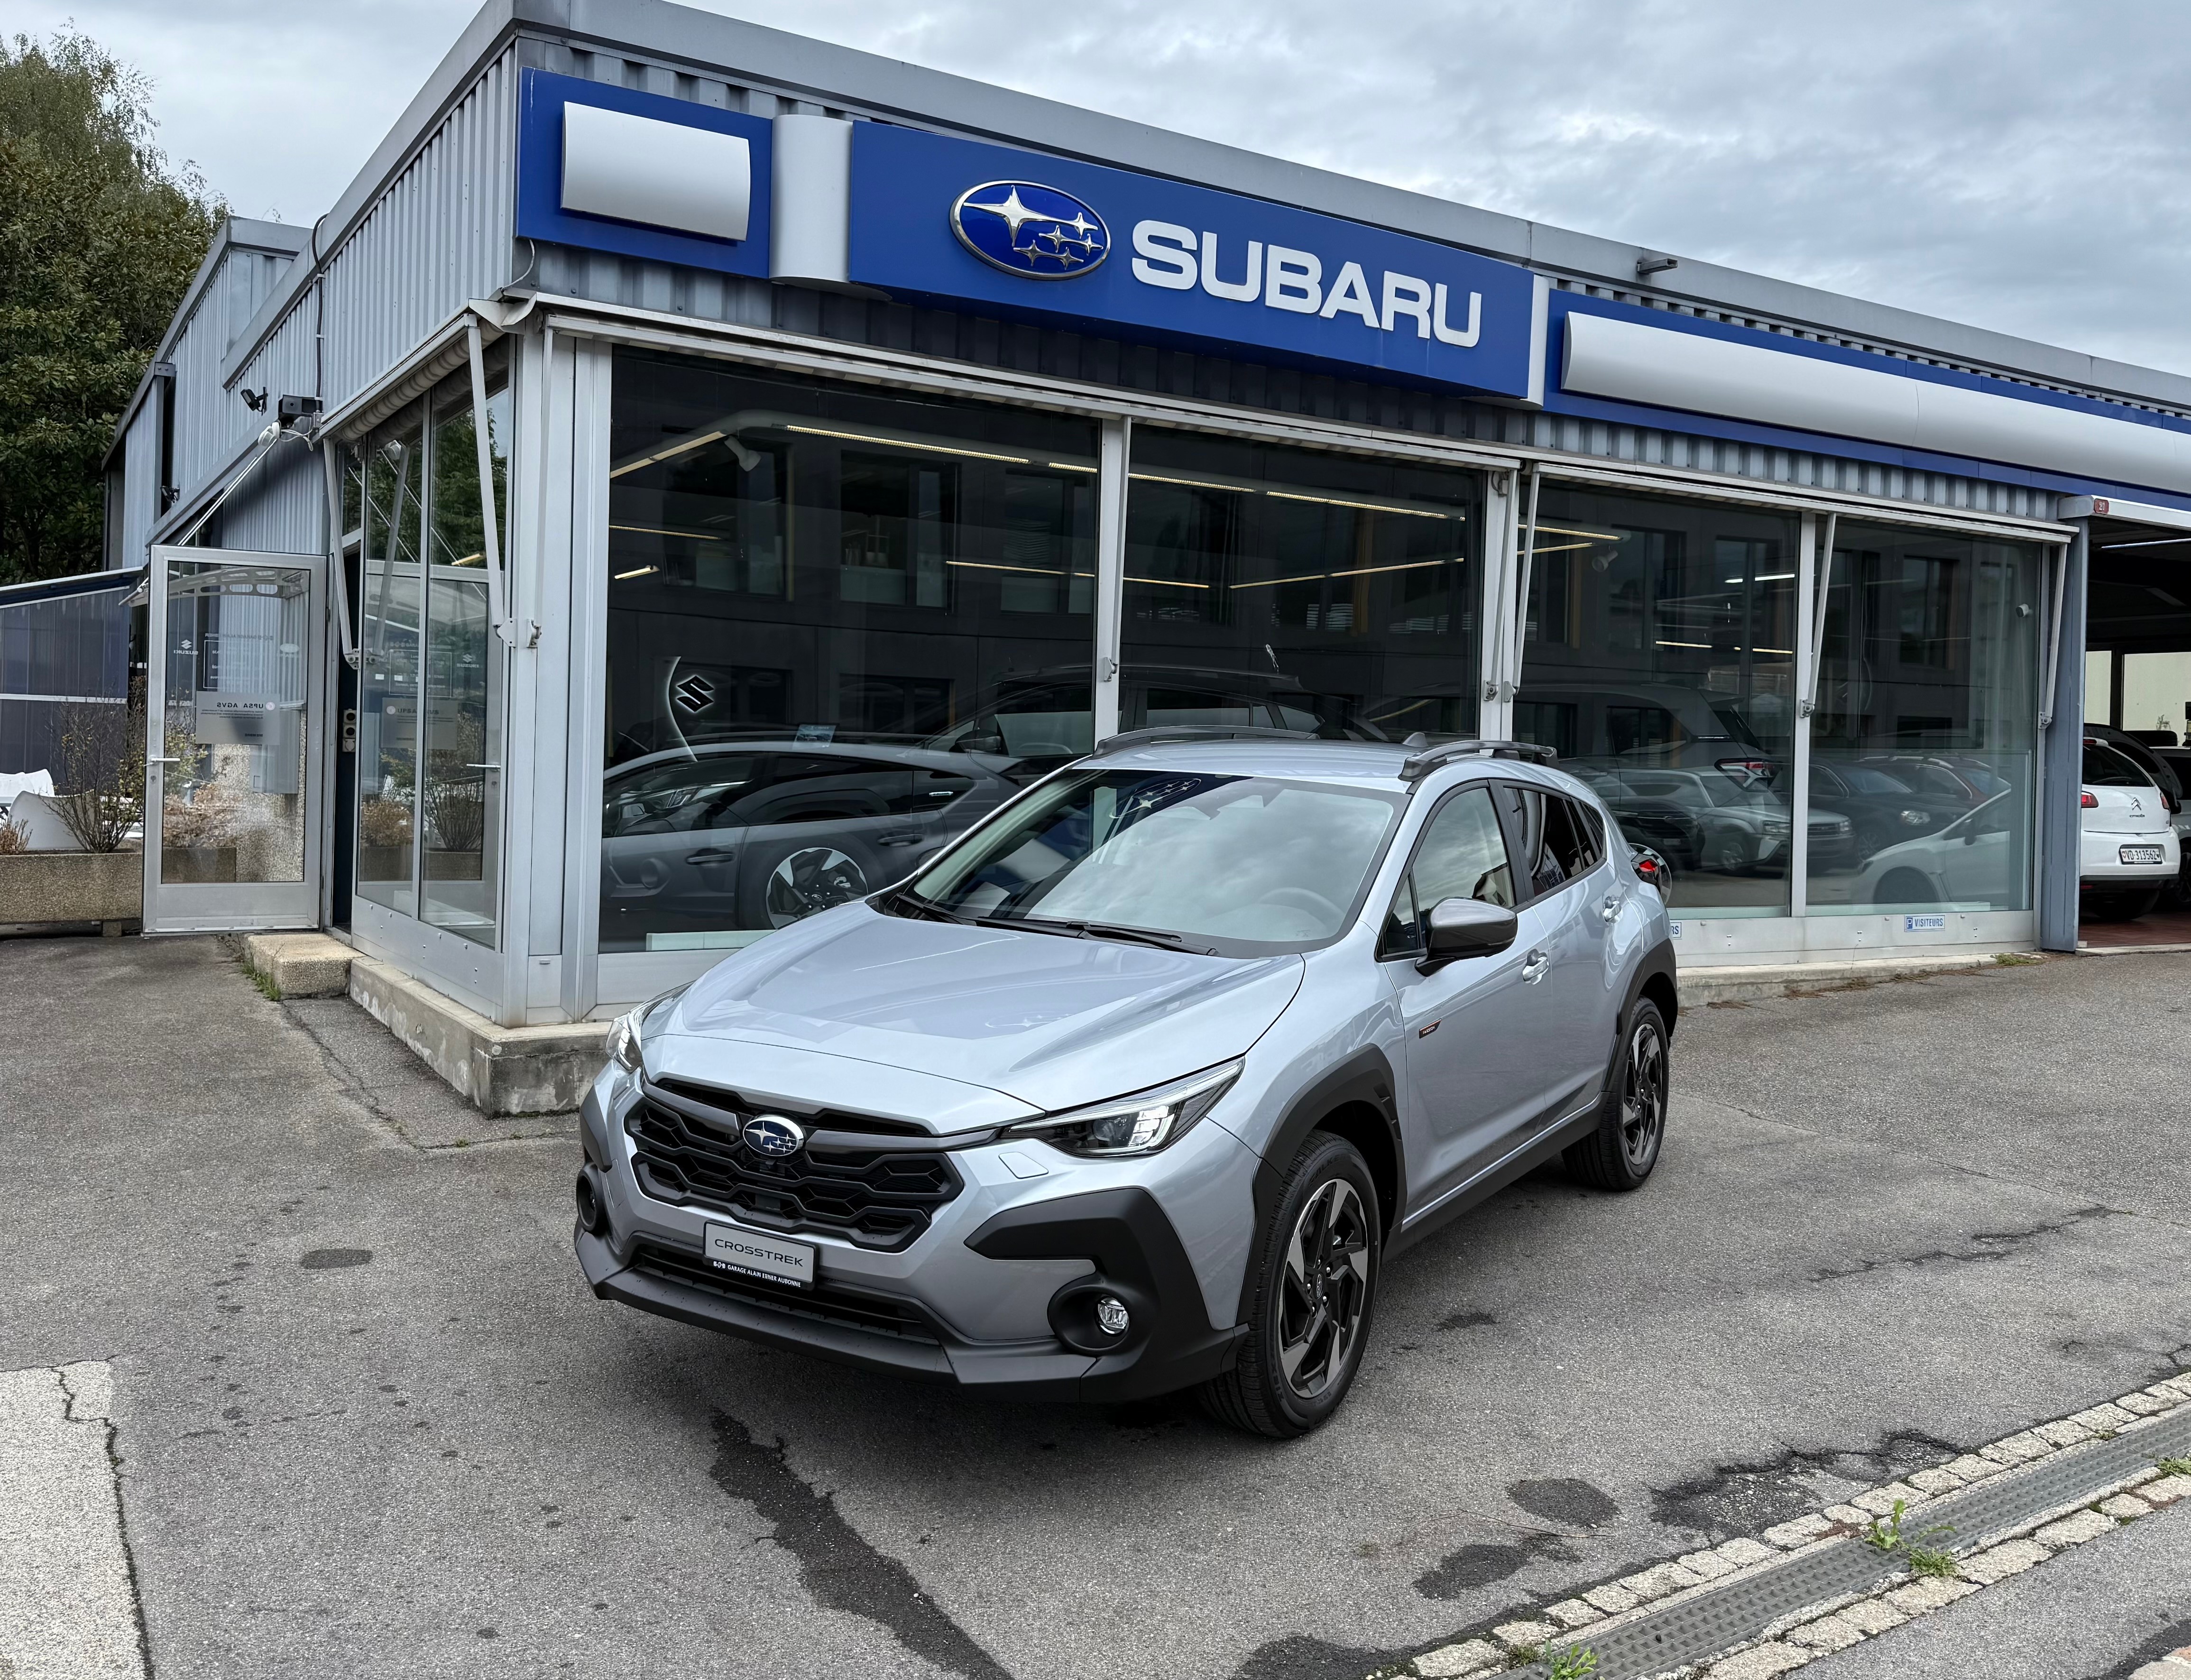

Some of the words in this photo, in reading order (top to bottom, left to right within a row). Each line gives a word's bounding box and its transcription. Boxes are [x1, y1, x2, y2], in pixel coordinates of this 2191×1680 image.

[1131, 219, 1482, 349] SUBARU
[2099, 501, 2106, 511] 21
[1915, 918, 1943, 927] VISITEURS
[715, 1238, 803, 1267] CROSSTREK
[727, 1265, 746, 1274] GARAGE
[747, 1269, 761, 1278] ALAIN
